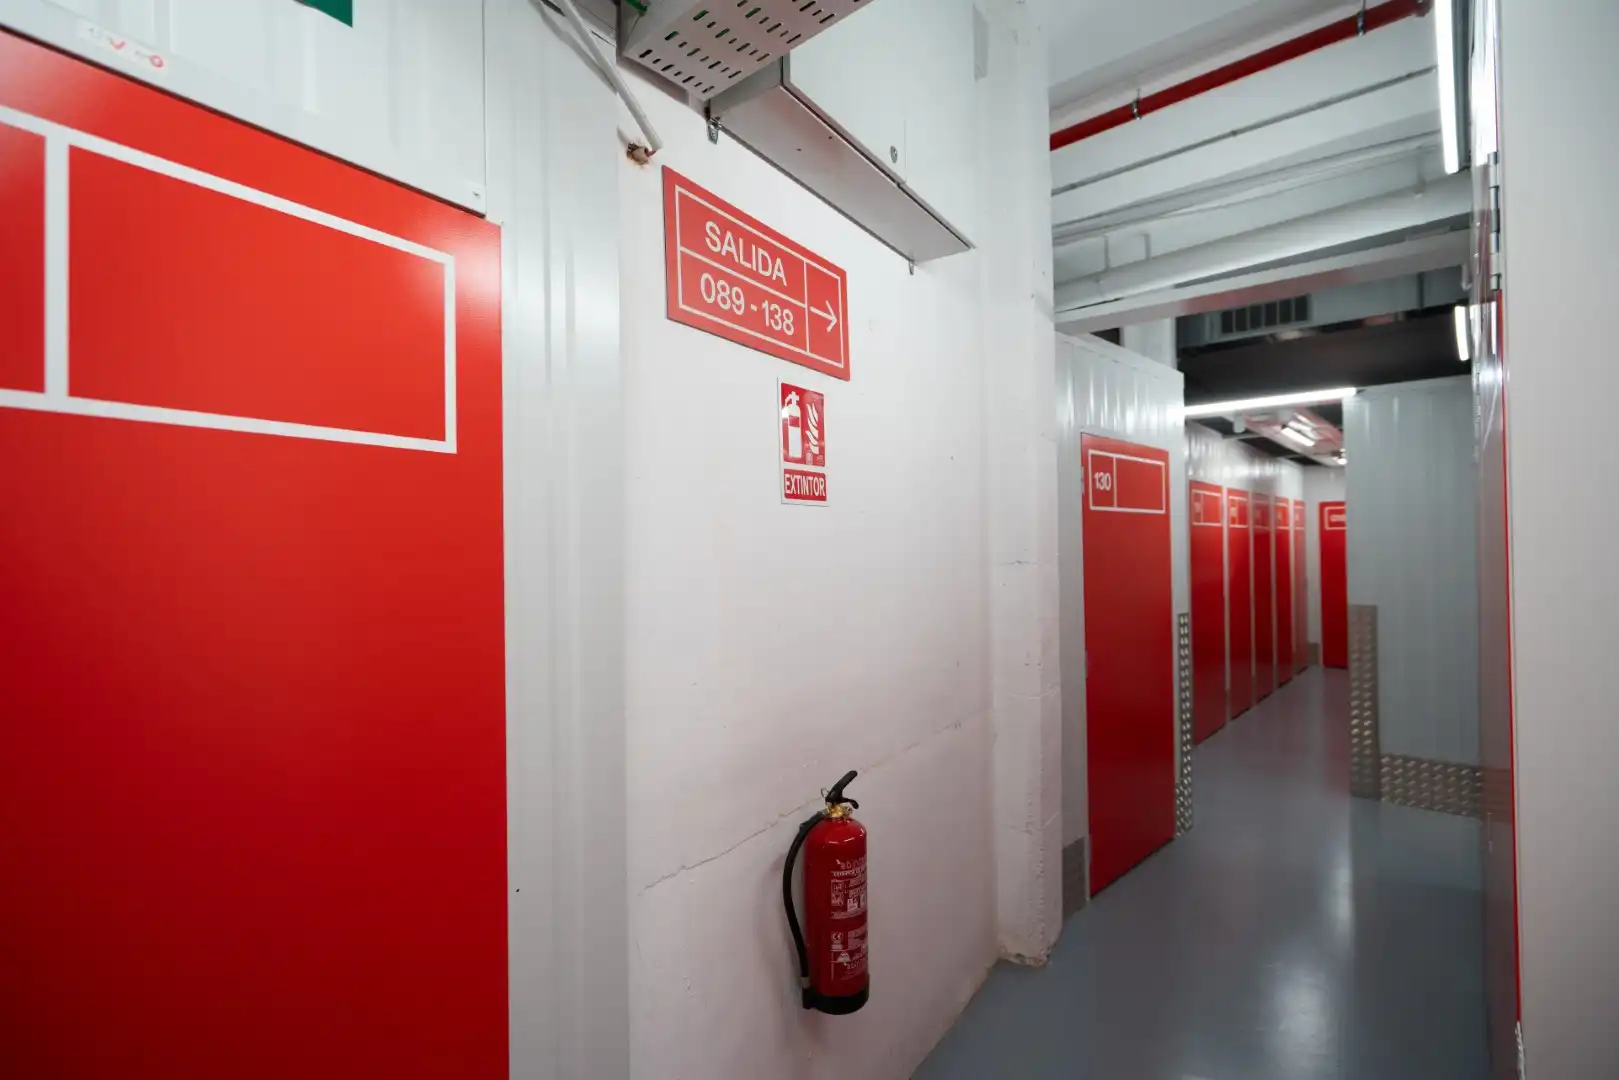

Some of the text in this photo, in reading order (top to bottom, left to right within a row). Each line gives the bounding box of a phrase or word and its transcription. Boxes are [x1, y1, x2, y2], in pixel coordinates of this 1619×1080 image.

[704, 221, 788, 286] SALIDA
[701, 272, 745, 316] 089
[762, 300, 794, 336] 138
[785, 473, 826, 498] EXTINTOR
[1094, 472, 1111, 491] 130
